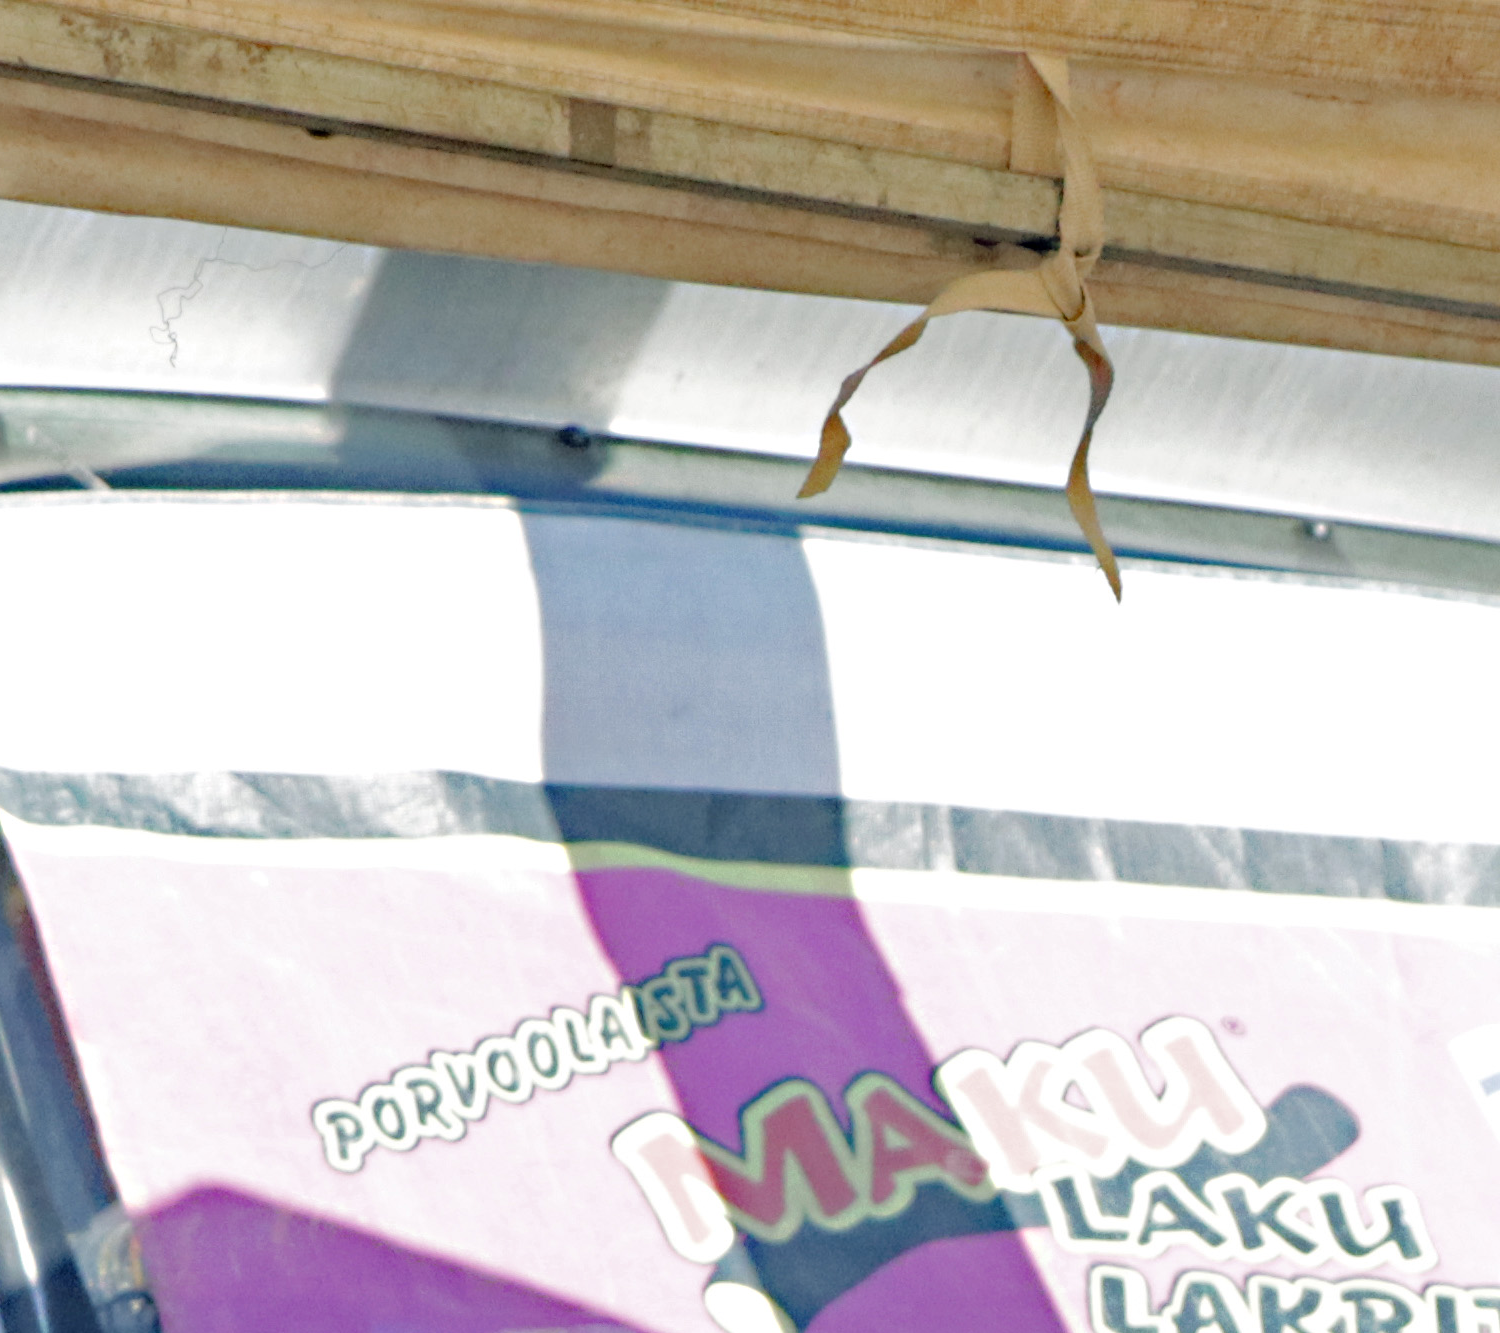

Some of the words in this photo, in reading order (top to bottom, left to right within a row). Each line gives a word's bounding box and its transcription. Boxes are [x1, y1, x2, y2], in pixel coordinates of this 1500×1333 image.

[318, 946, 758, 1166] PORVOOLAISTA
[618, 1024, 1258, 1256] MAKU
[1044, 1171, 1430, 1265] LAKU
